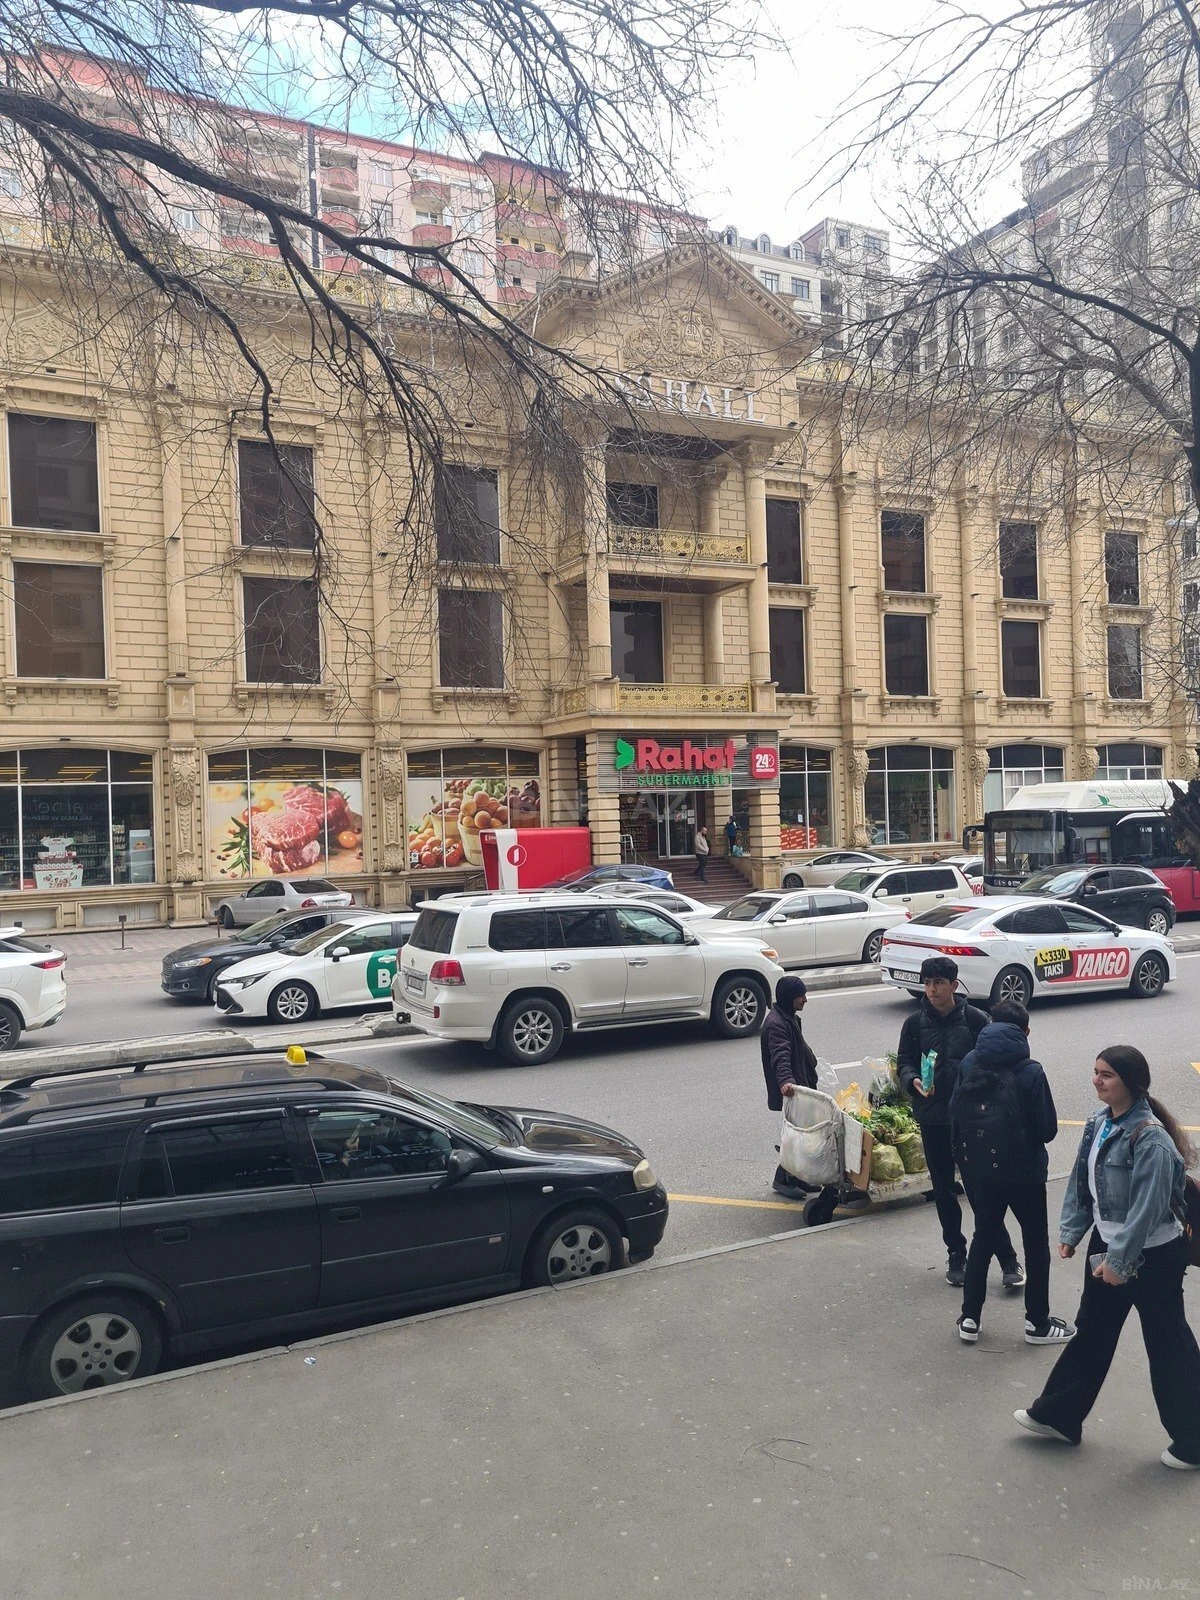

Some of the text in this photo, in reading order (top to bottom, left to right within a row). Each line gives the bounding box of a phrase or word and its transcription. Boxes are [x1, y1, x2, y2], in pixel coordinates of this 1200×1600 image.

[662, 379, 766, 423] HALL
[637, 738, 737, 771] Rahat
[755, 753, 769, 768] 24
[637, 774, 733, 786] SUPERMARKET
[1043, 961, 1064, 978] TAKSİ
[1075, 951, 1127, 978] YANGO
